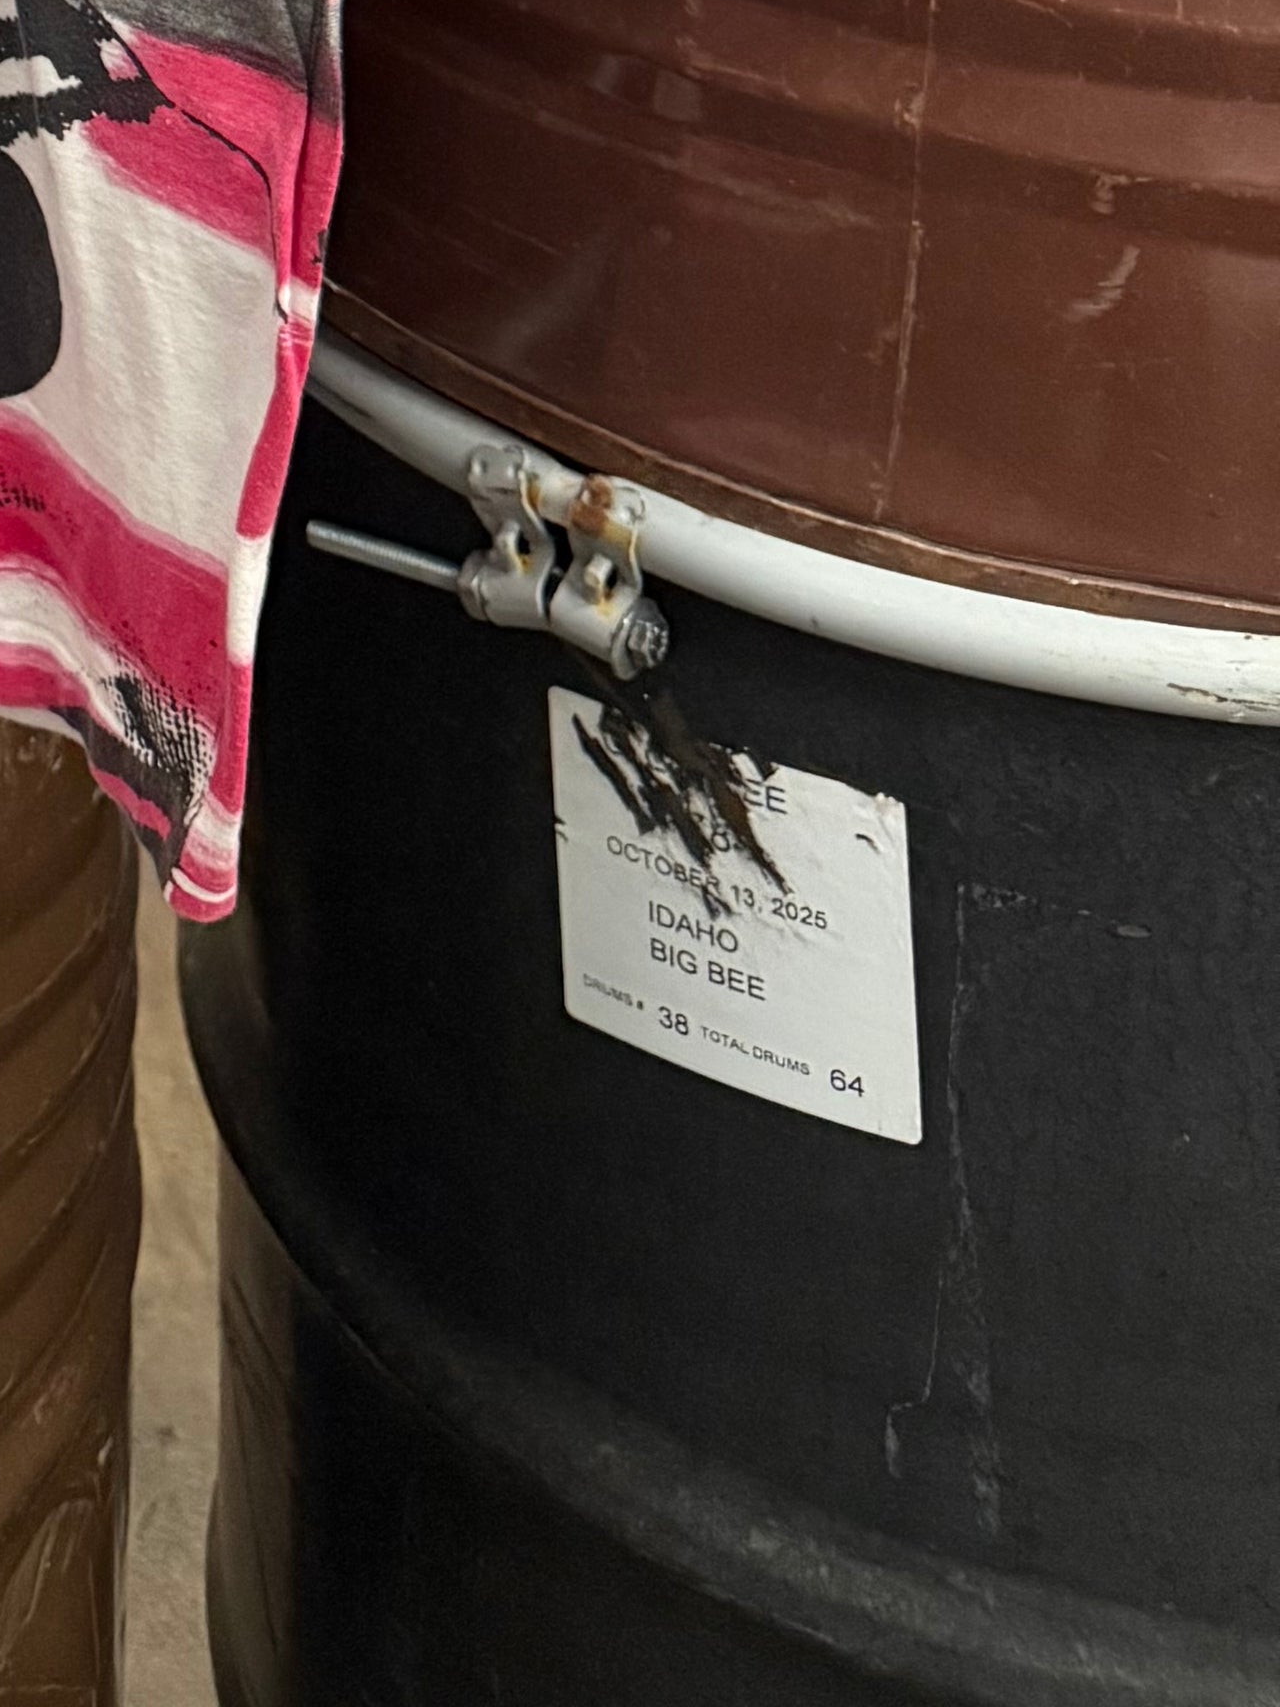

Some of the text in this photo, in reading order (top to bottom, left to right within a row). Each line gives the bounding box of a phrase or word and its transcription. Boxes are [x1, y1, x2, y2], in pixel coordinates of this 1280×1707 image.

[606, 835, 721, 894] OCTOBER
[770, 898, 828, 930] 2025
[648, 900, 739, 954] IDAHO
[649, 937, 767, 1002] BIG BEE
[658, 1005, 690, 1037] 38
[699, 1025, 750, 1057] TOTAL
[752, 1044, 811, 1077] DRUMS
[830, 1068, 866, 1098] 64
